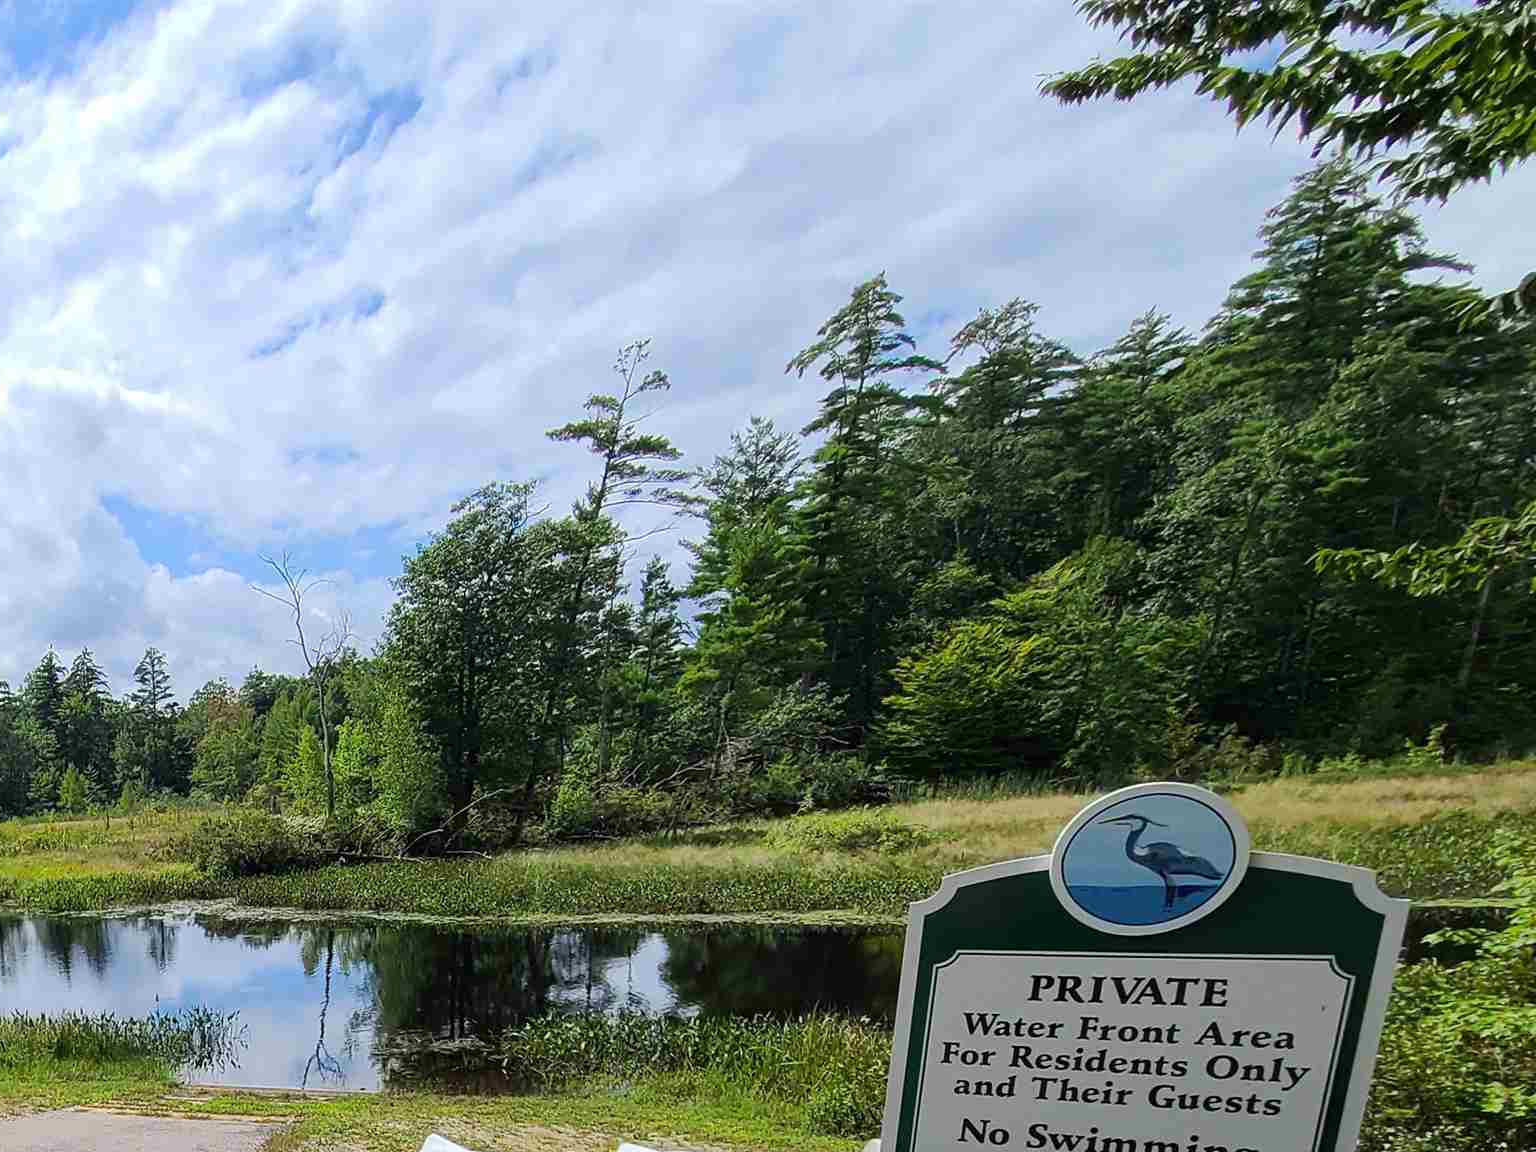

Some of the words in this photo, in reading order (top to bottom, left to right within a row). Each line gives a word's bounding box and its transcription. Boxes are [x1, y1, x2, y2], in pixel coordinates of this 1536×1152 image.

[1026, 974, 1228, 1007] PRIVATE
[963, 1012, 1064, 1039] Water
[1076, 1016, 1181, 1044] Front
[1193, 1021, 1295, 1050] Area
[940, 1041, 997, 1066] For
[1008, 1045, 1188, 1078] Residents
[1205, 1054, 1311, 1092] Only
[953, 1075, 1017, 1098] and
[1031, 1076, 1133, 1106] Their
[1148, 1084, 1282, 1116] Guests
[957, 1118, 1010, 1146] No
